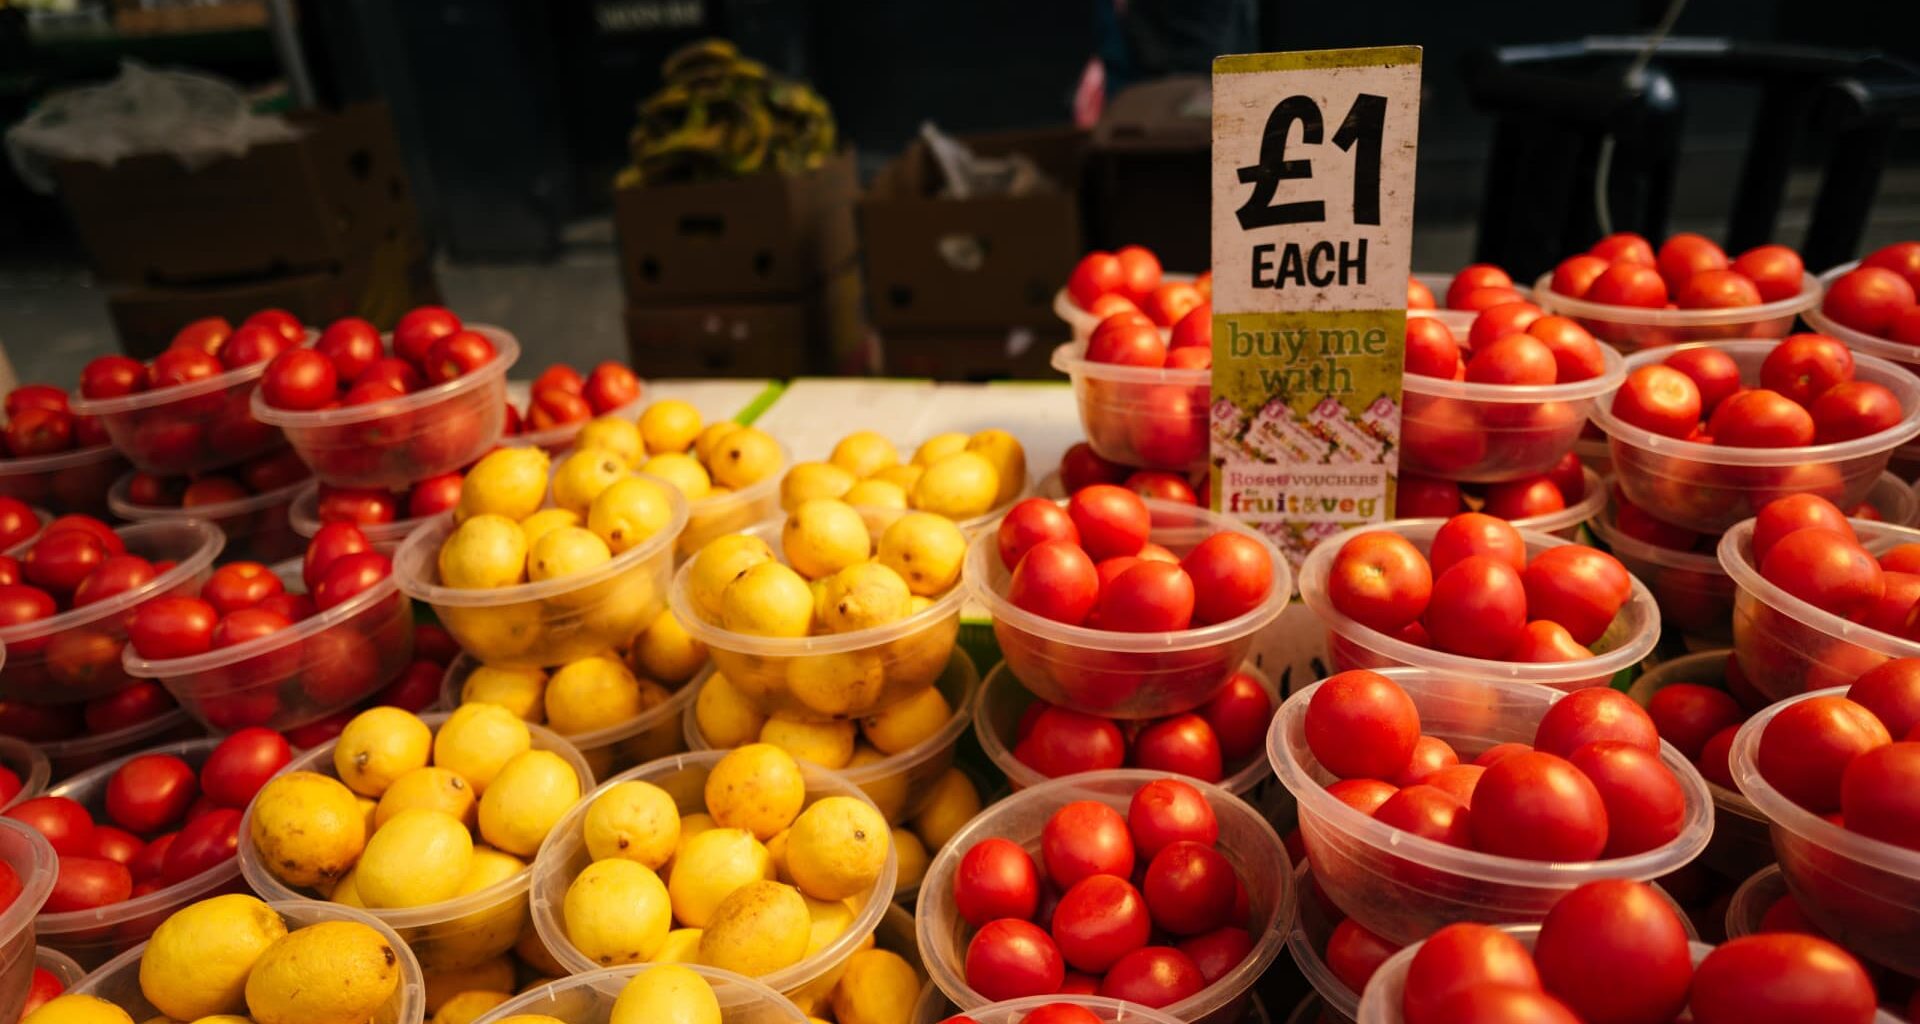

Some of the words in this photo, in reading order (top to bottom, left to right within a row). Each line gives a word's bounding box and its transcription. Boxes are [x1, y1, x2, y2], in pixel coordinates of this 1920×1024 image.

[1235, 93, 1388, 231] £1
[1251, 238, 1369, 289] EACH
[1228, 322, 1310, 366] buy
[1318, 327, 1387, 356] me
[1259, 357, 1353, 394] with
[1291, 472, 1378, 487] VOUCHERS
